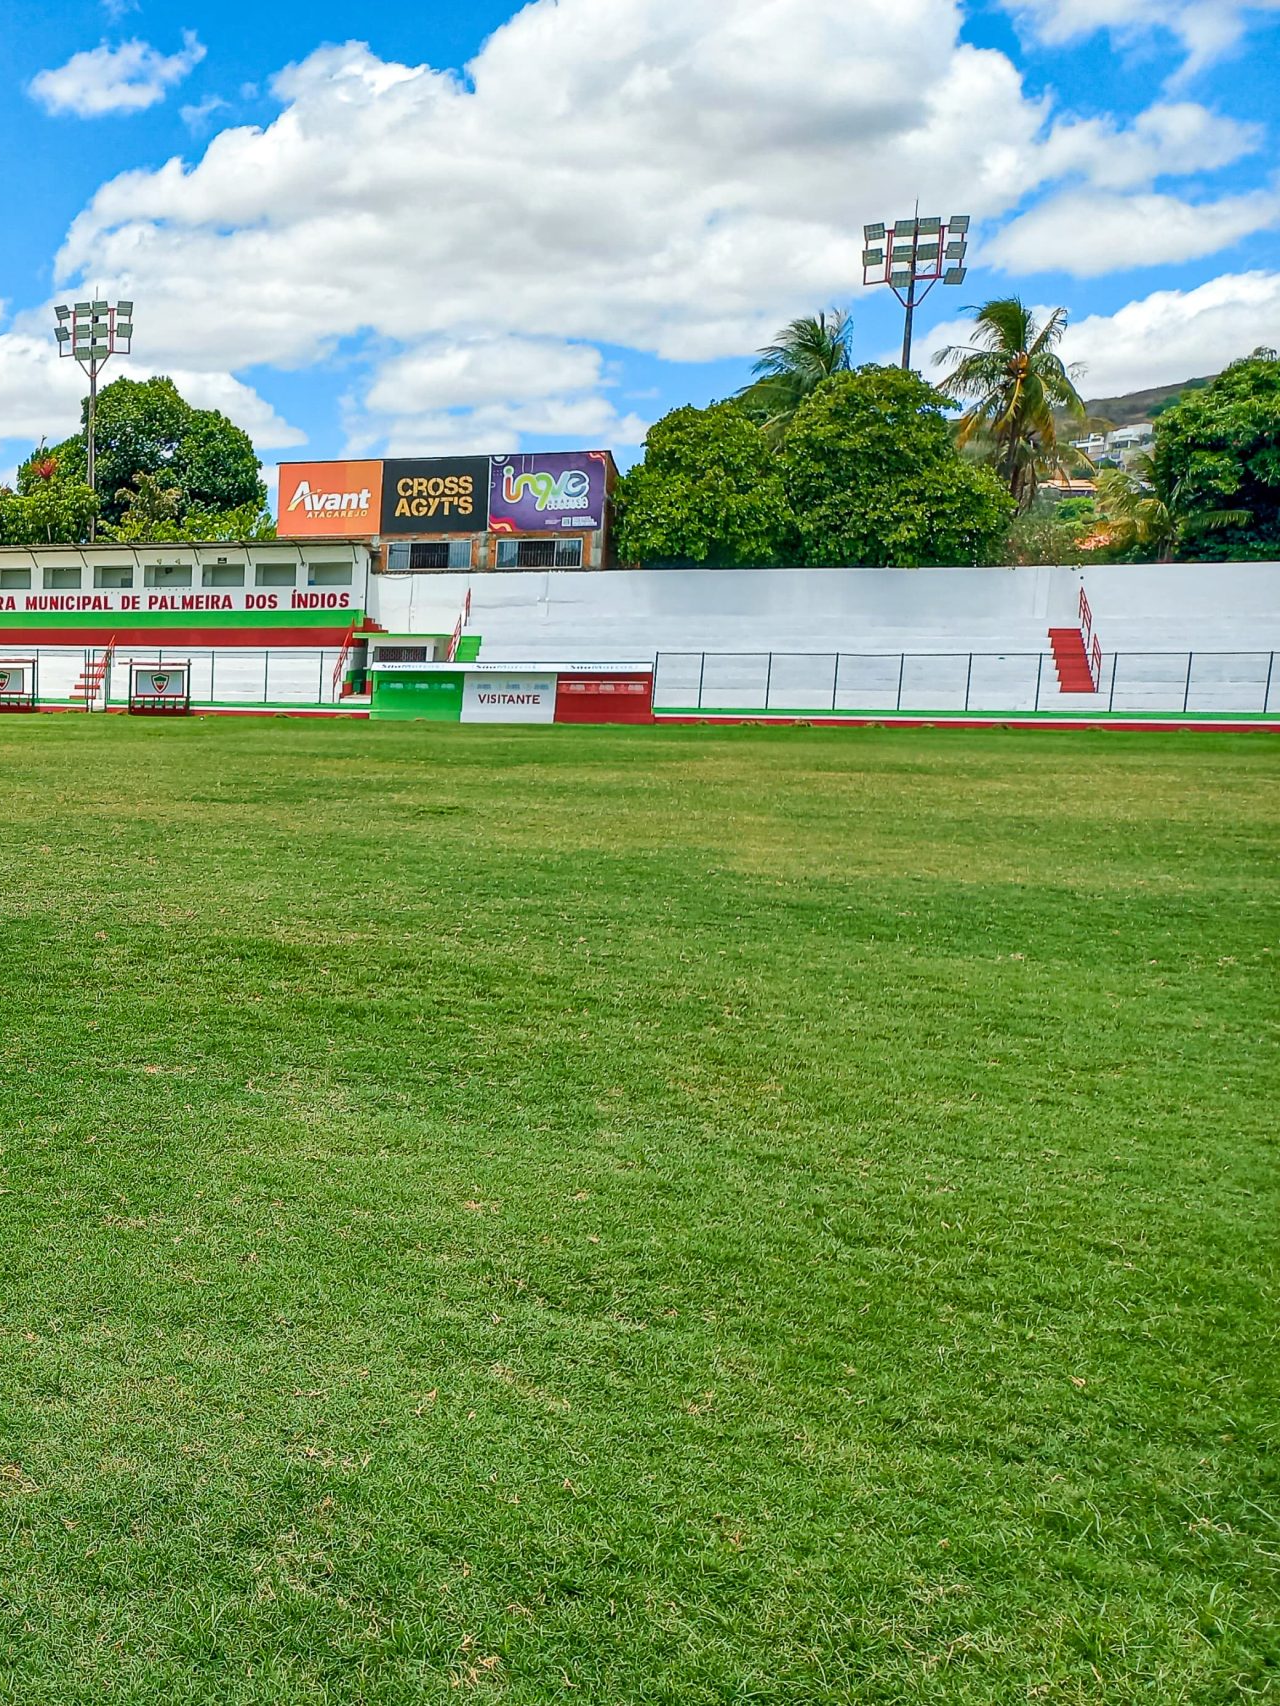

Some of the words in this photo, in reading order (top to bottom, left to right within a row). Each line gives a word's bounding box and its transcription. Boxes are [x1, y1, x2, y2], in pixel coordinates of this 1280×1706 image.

[287, 480, 371, 512] Avant
[396, 475, 474, 497] CROSS
[307, 509, 369, 519] ATACAREJO
[25, 595, 114, 610] MUNICIPAL
[121, 595, 140, 610] DE
[148, 594, 233, 610] PALMEIRA
[245, 593, 278, 609] DOS
[291, 589, 350, 609] ÍNDIOS
[478, 693, 541, 705] VISITANTE
